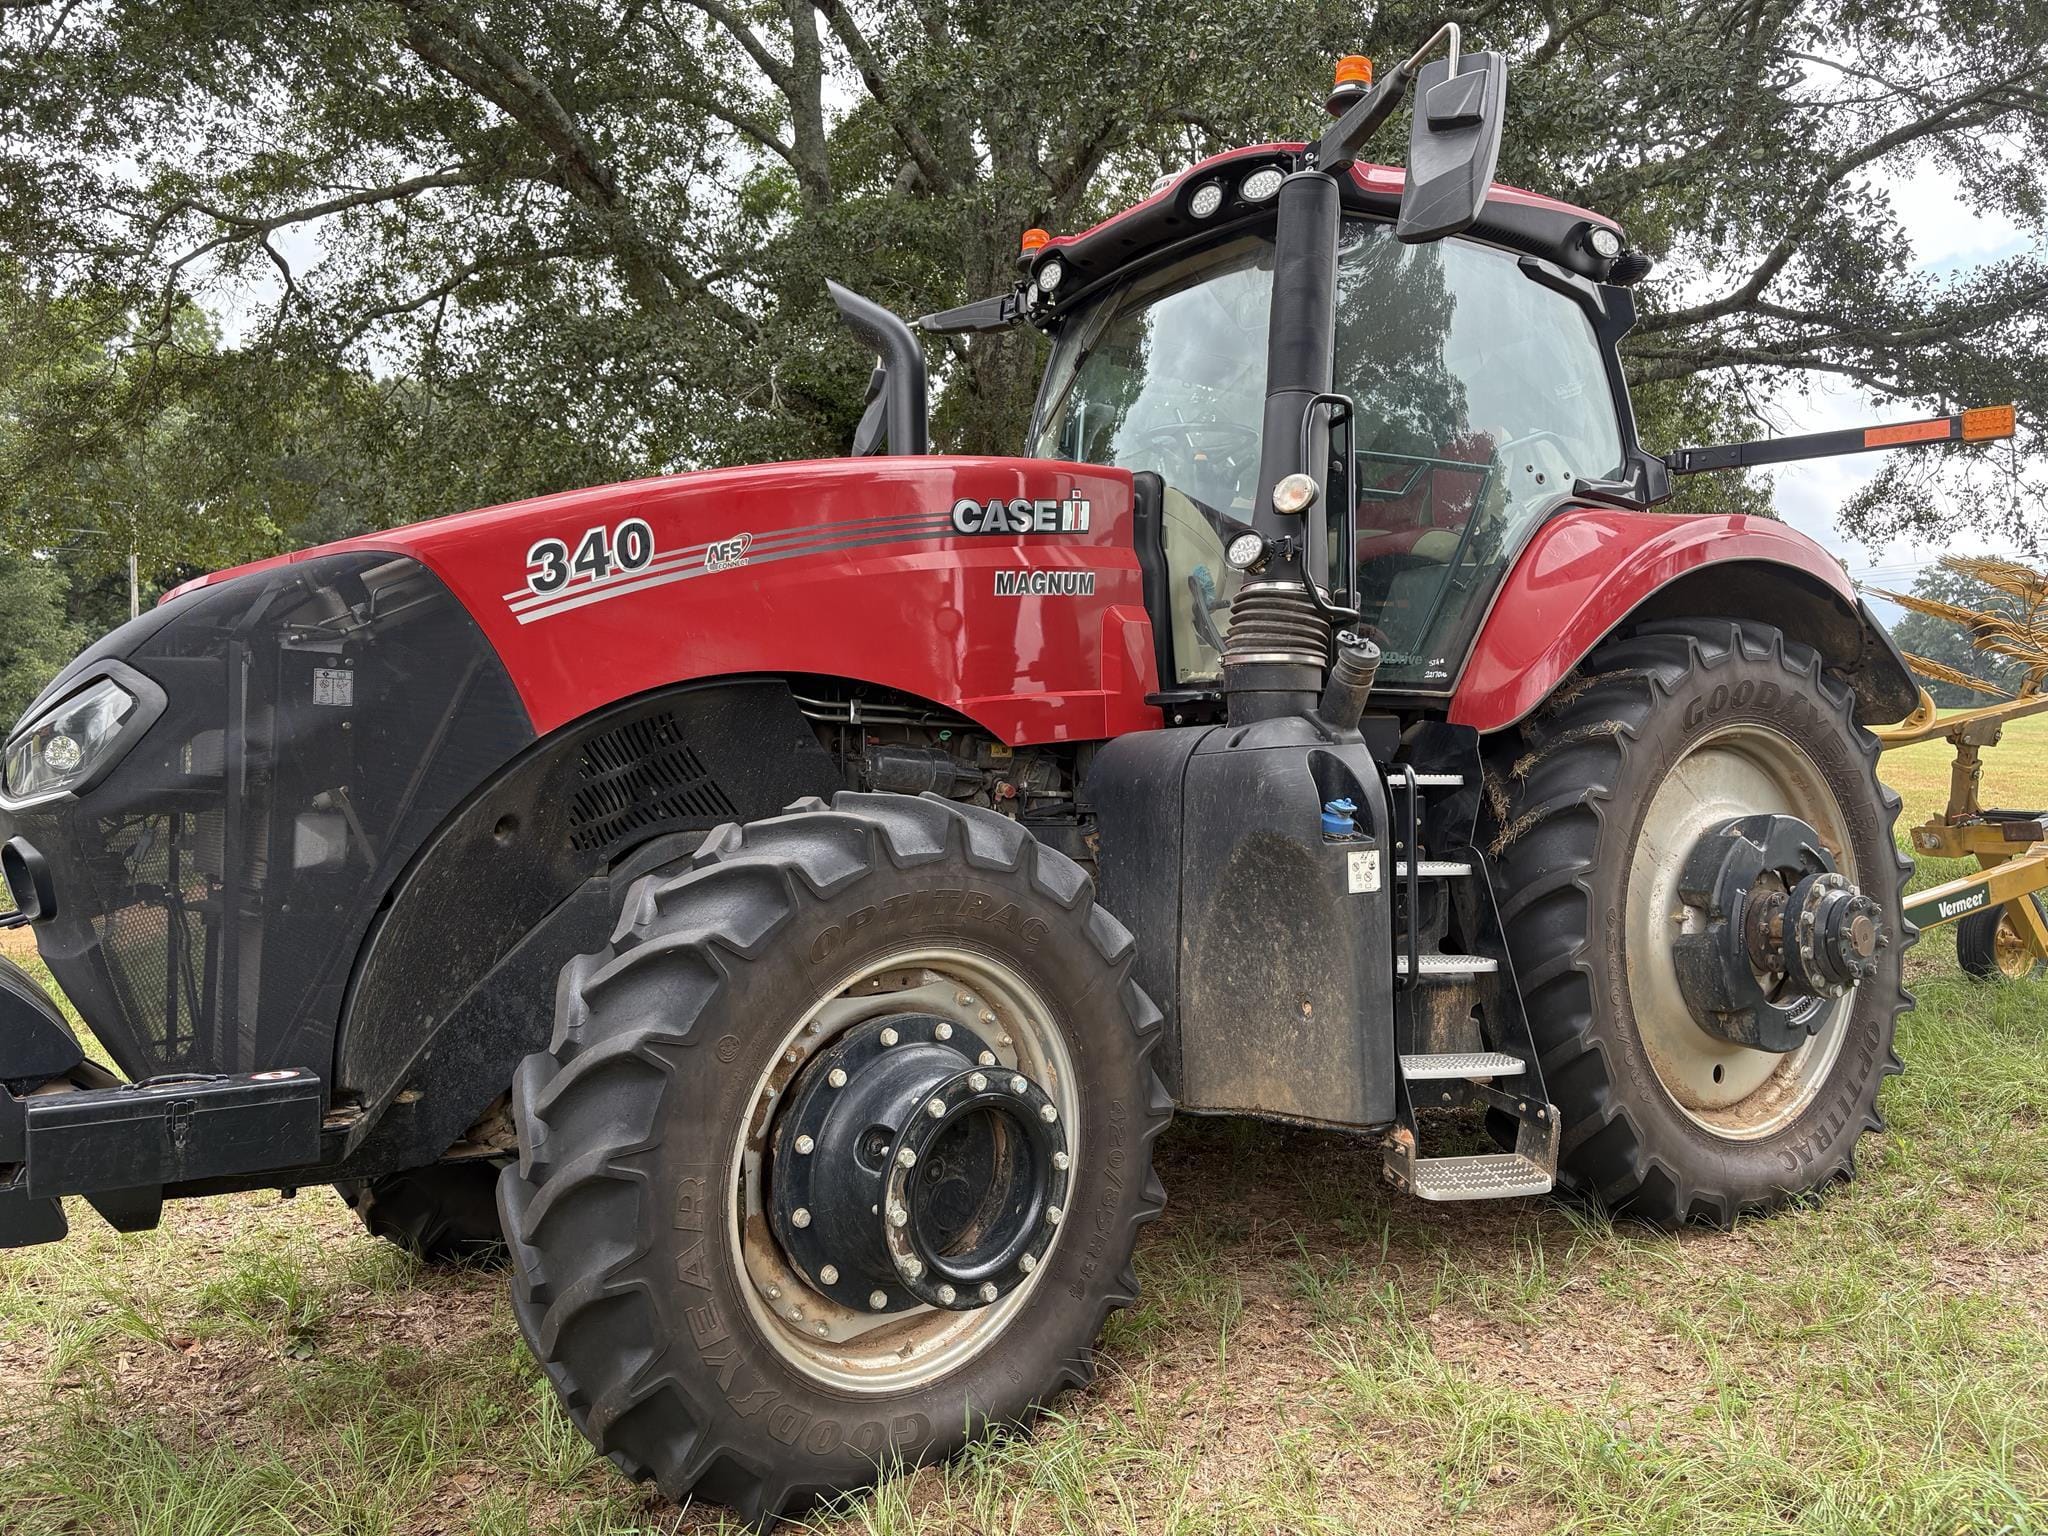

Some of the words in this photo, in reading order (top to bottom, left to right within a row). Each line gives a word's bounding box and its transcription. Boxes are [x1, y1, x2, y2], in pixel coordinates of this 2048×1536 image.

[952, 497, 1058, 534] CASE
[527, 518, 655, 595] 340
[704, 537, 744, 565] AFS
[717, 557, 750, 571] CONNECT
[994, 570, 1096, 597] MAGNUM
[1938, 892, 1984, 918] Vermeer
[810, 888, 1050, 965] OPTITRAC
[1776, 1020, 1881, 1173] OPTITRAC
[675, 1175, 936, 1459] GOODYEAR
